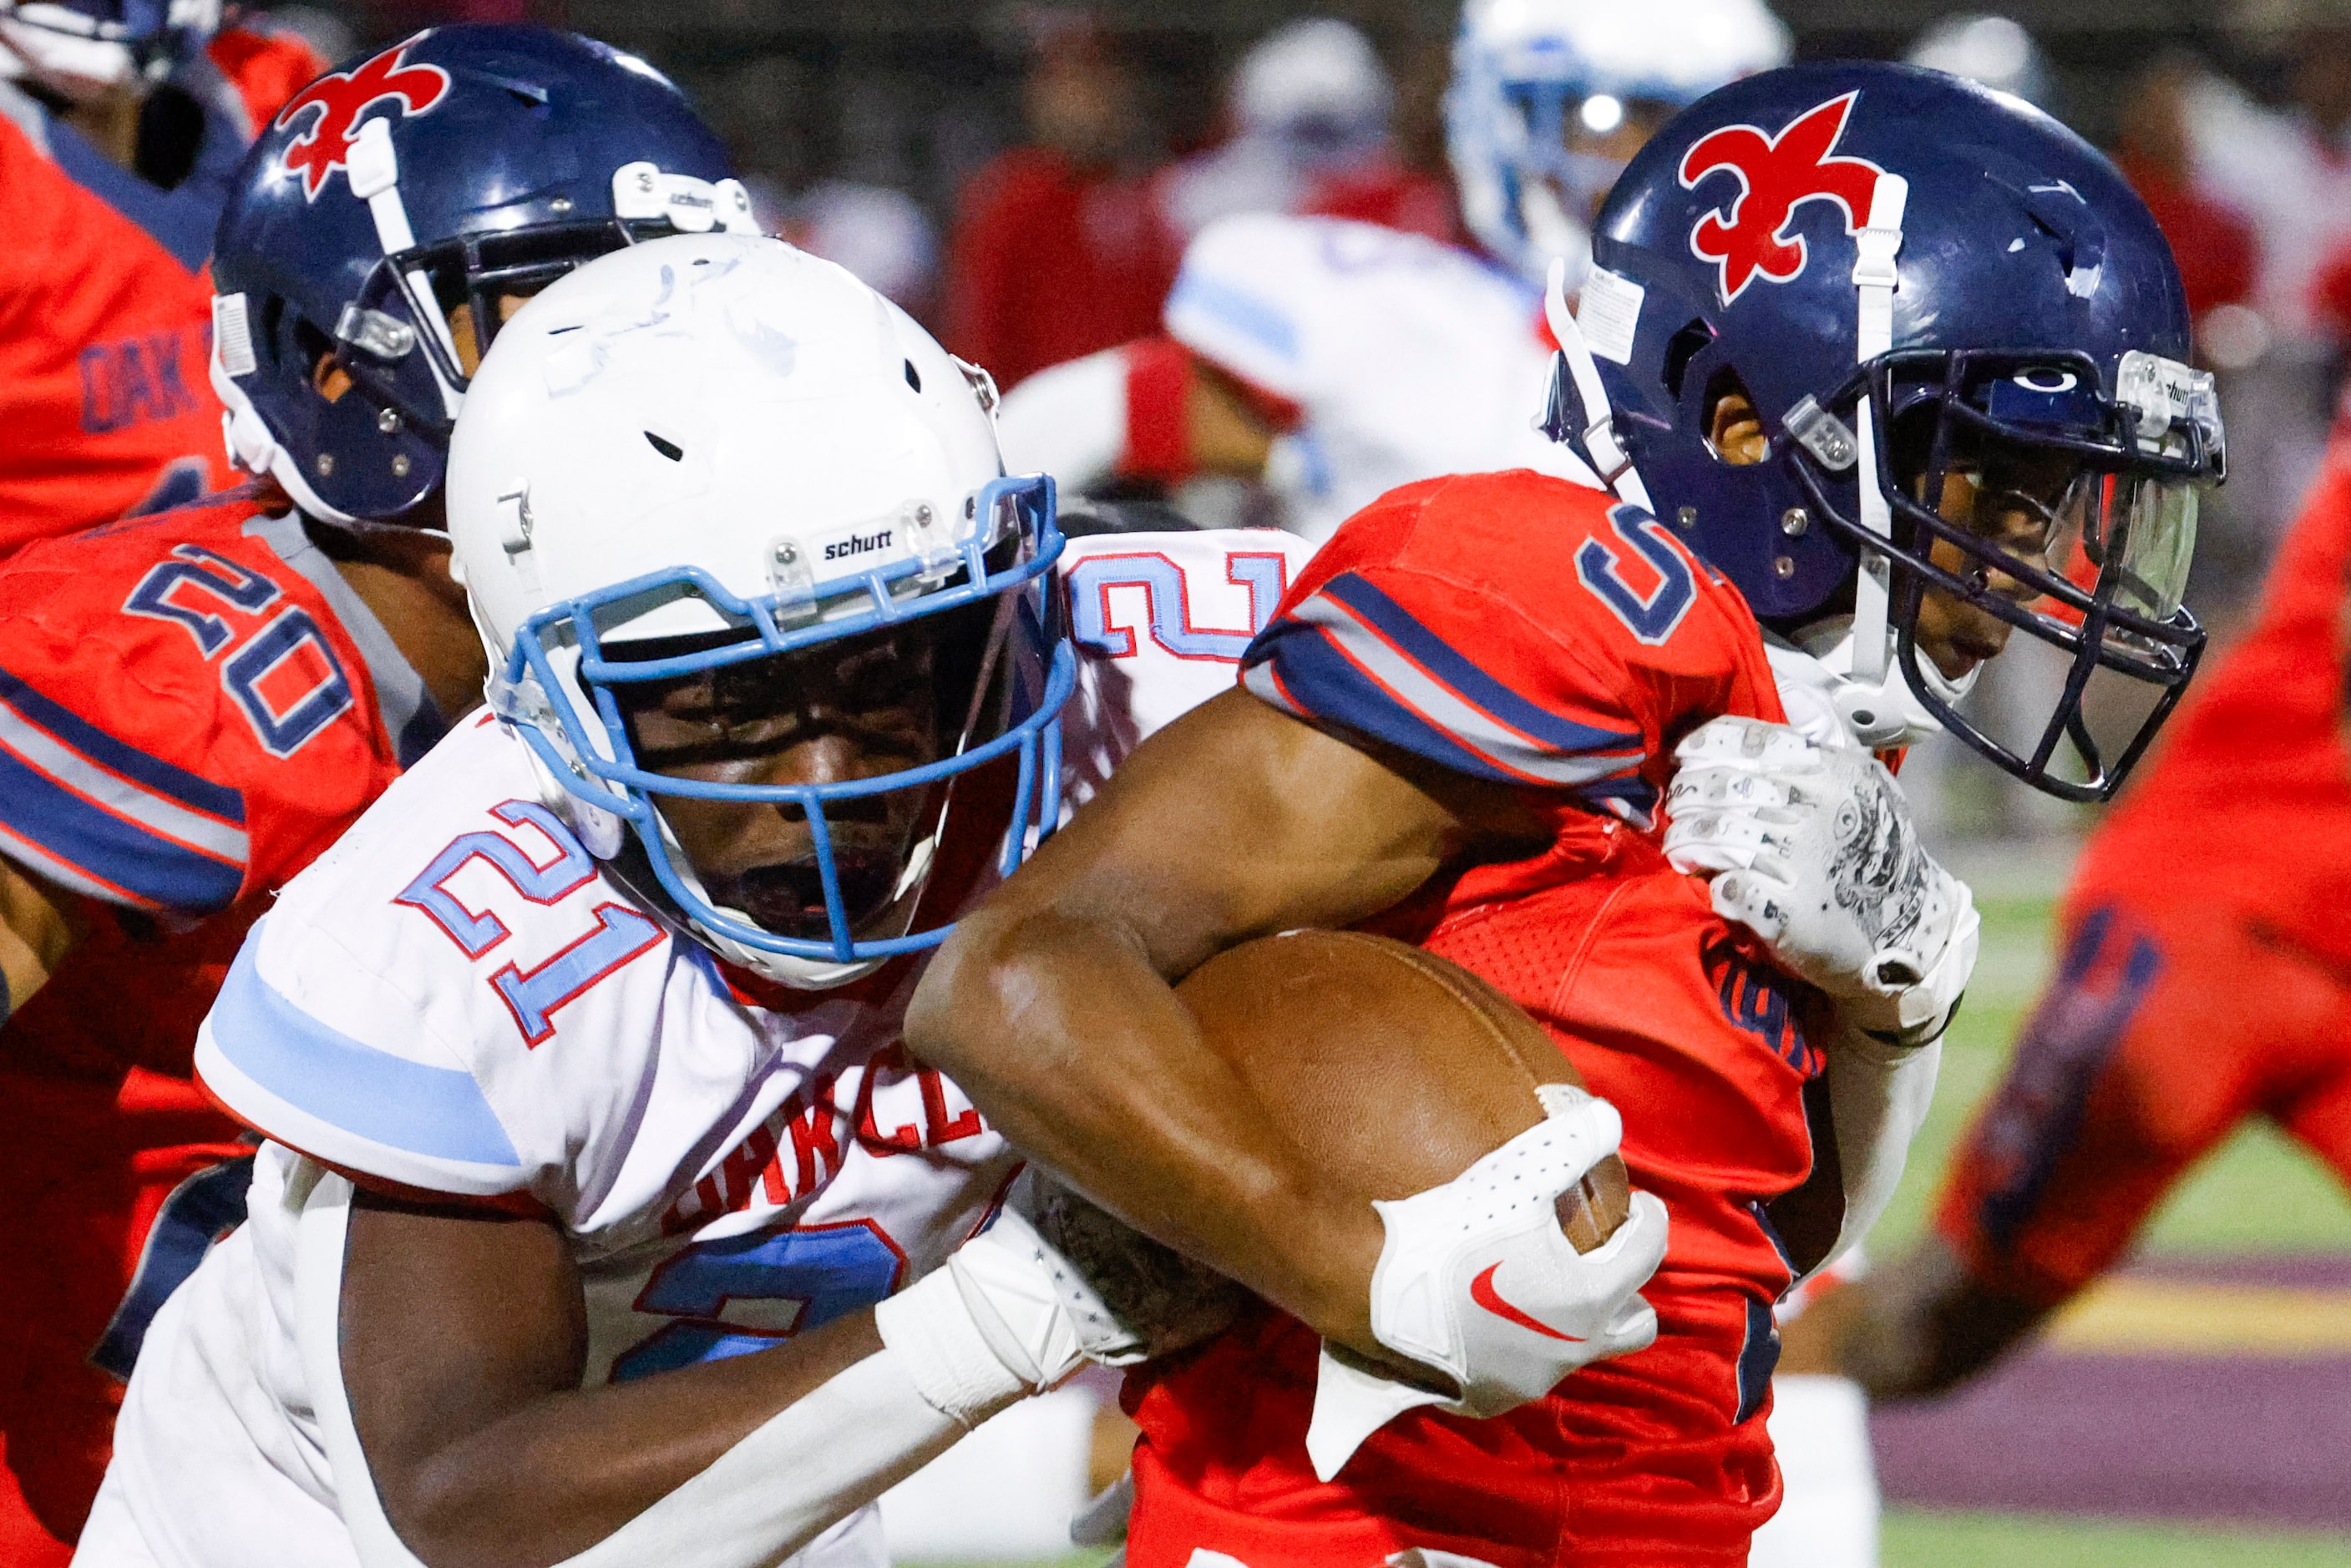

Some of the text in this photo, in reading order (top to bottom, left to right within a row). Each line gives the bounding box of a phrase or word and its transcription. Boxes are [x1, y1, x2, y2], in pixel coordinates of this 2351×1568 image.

[79, 334, 199, 434] OAK
[824, 530, 892, 560] schutt
[120, 543, 355, 760] 20
[389, 798, 668, 1050] 21
